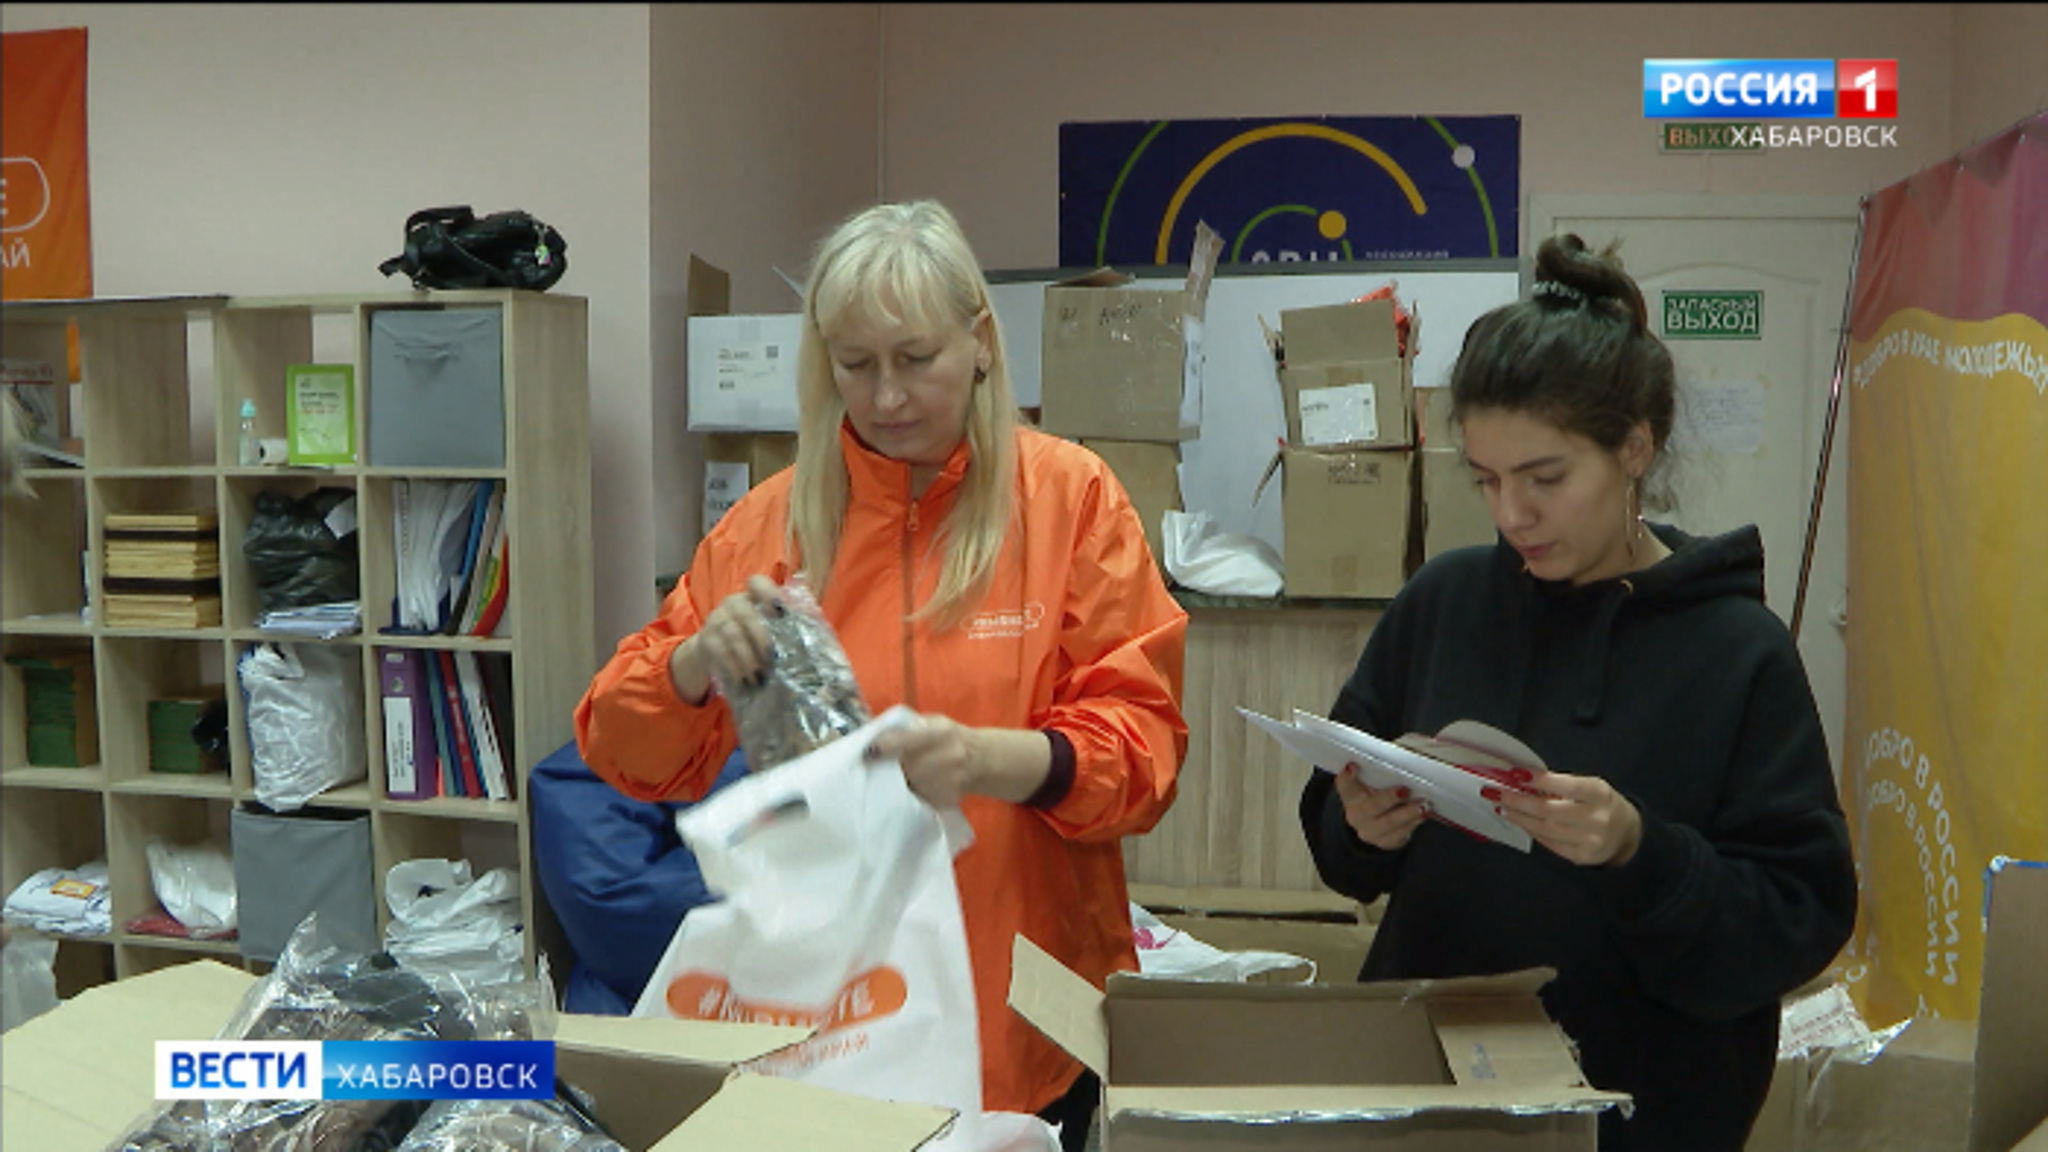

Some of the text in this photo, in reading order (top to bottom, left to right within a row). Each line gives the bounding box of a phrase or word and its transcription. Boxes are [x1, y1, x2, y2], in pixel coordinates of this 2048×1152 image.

[1668, 126, 1742, 147] ВЫХ
[1667, 294, 1757, 312] ЗАПАСНЫЙ
[1667, 311, 1757, 333] ВЫХОД
[1915, 753, 1930, 789] В
[1928, 780, 1960, 986] РОССИИ
